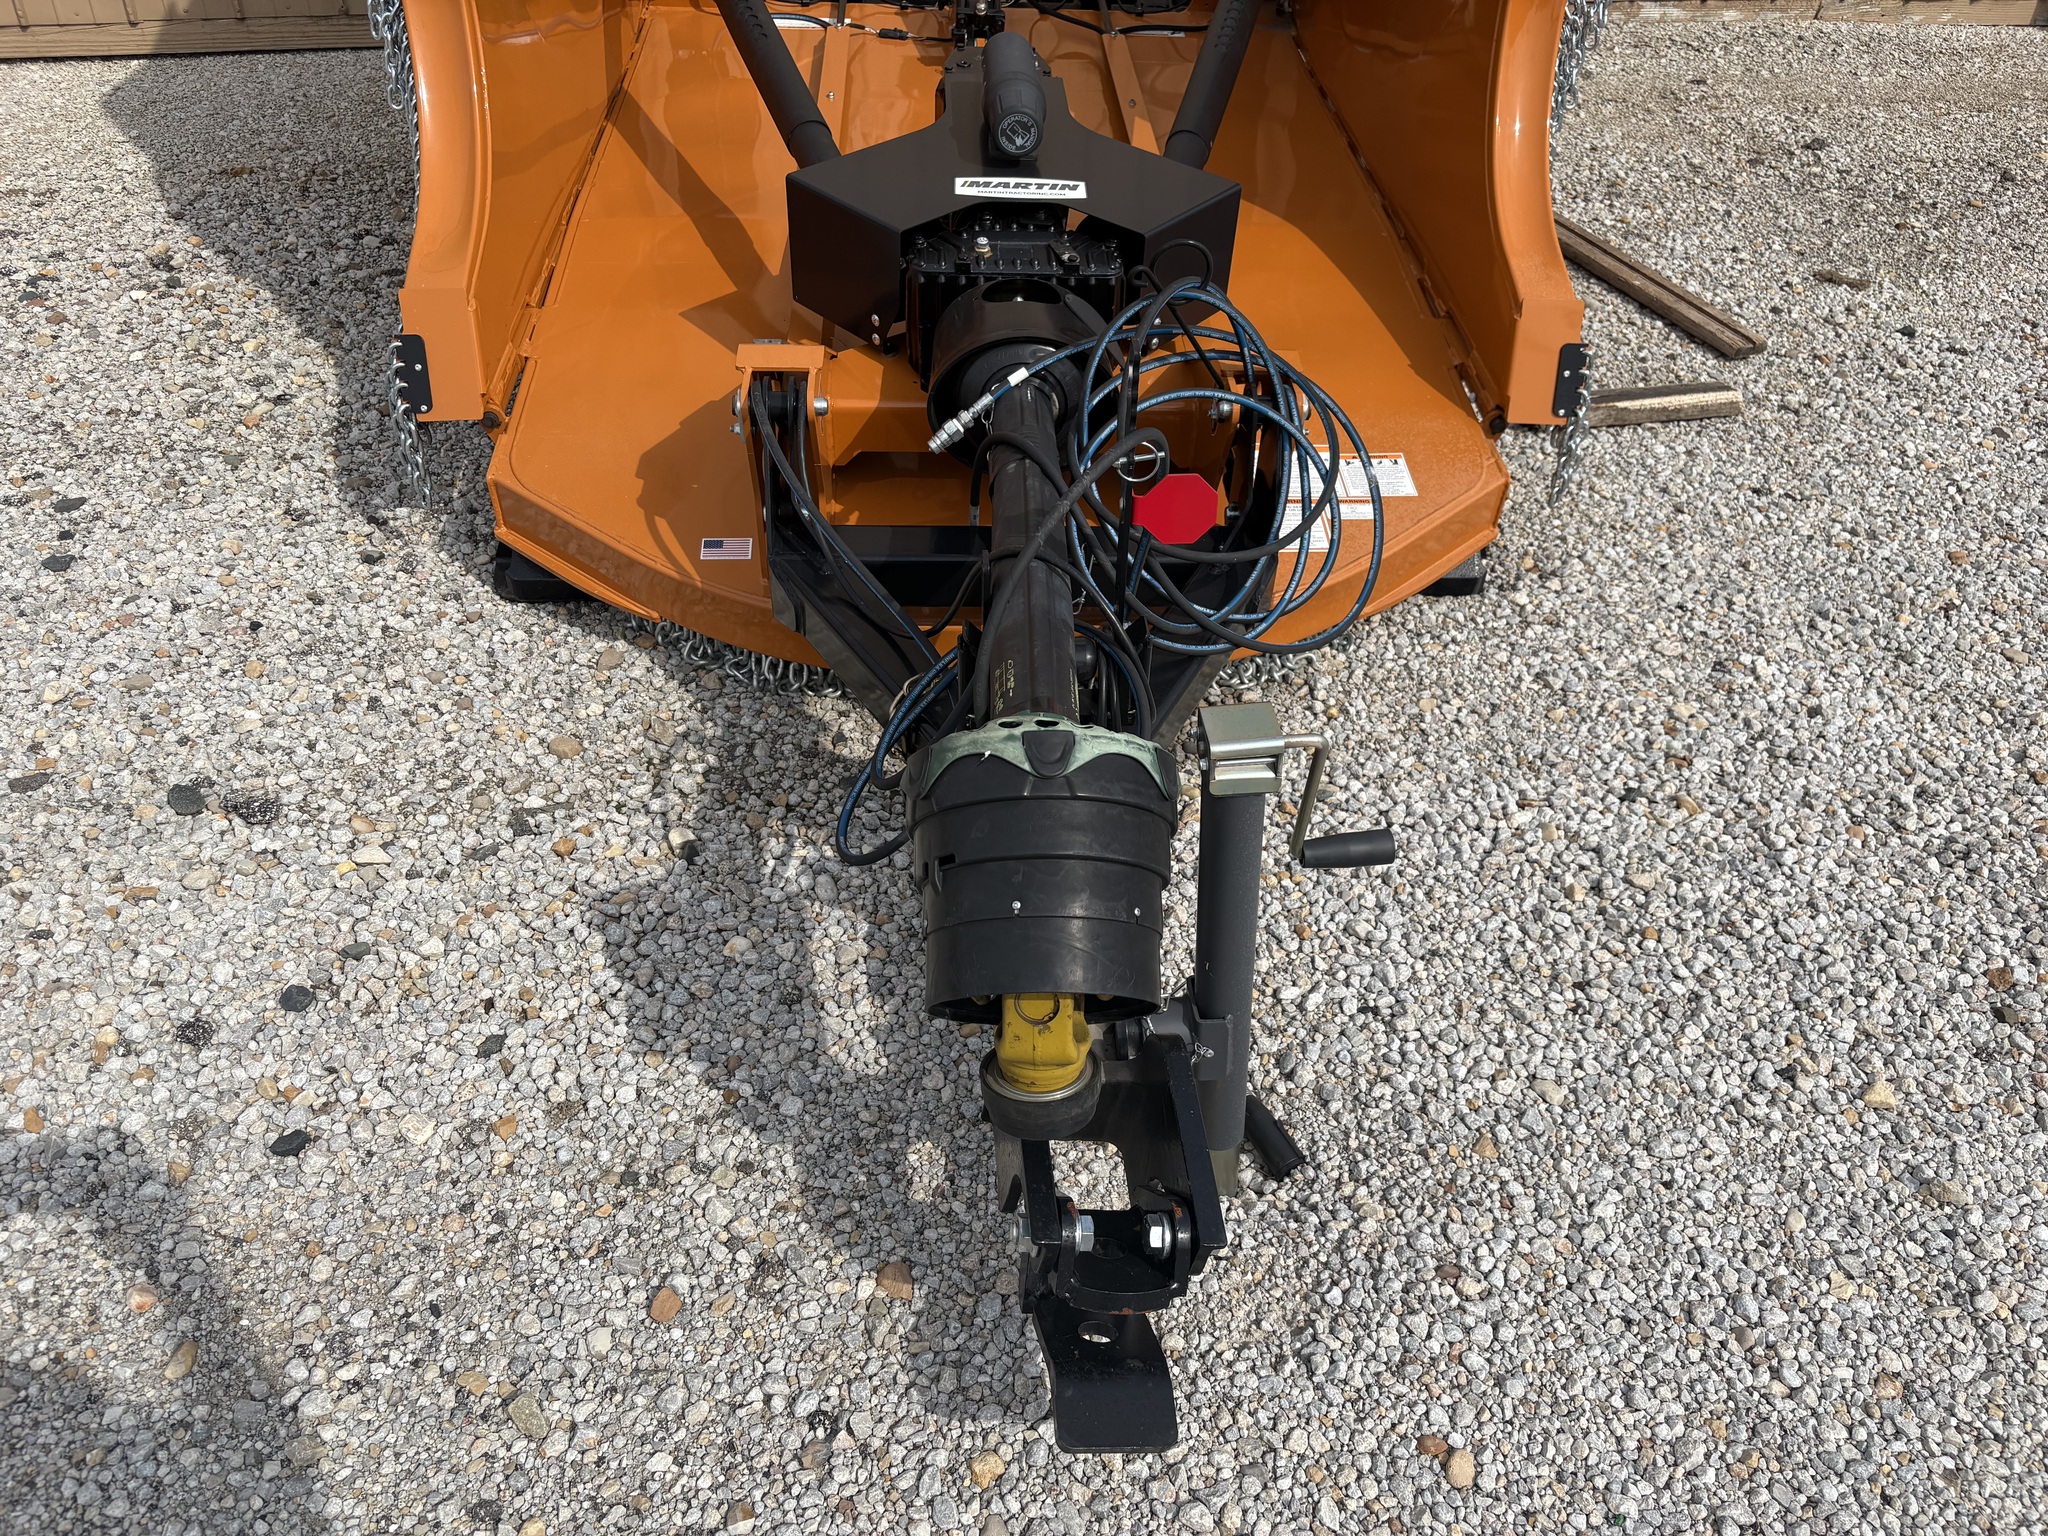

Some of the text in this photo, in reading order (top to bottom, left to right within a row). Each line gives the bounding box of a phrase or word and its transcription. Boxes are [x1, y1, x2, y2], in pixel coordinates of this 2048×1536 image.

[1002, 115, 1036, 148] OPERATOR'S MANUAL
[1001, 136, 1016, 151] INSIDE
[961, 180, 1080, 191] MARTIN
[935, 652, 955, 670] MINFLEX
